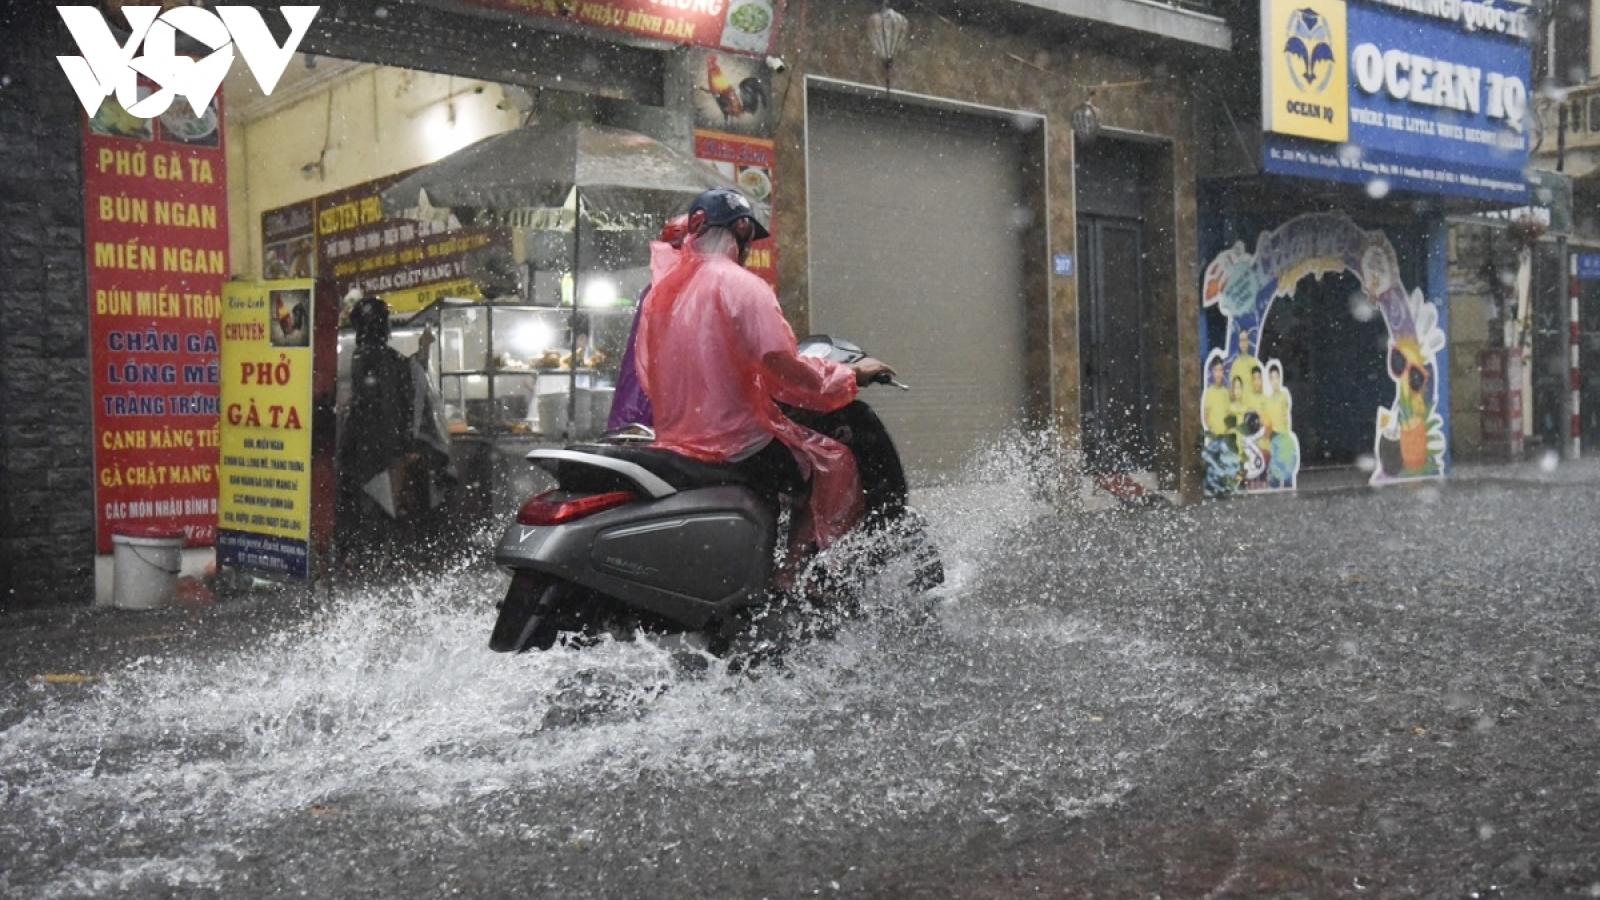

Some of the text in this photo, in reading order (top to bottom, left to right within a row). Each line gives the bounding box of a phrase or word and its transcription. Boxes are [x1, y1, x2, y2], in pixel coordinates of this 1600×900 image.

[1352, 42, 1527, 133] OCEAN IQ
[1287, 99, 1333, 124] OCEAN IQ
[1351, 107, 1384, 126] WHERE
[1386, 113, 1404, 130] THE
[1406, 117, 1435, 135] LITTLE
[100, 144, 213, 184] PHỞ GÀ TA
[99, 191, 217, 229] BÚN NGAN
[95, 237, 224, 274] MIẾN NGAN
[96, 285, 132, 316] BÚN
[136, 285, 180, 317] MIẾN
[108, 327, 219, 354] CHÂN GÀ
[224, 318, 264, 341] CHUYÊN
[240, 354, 291, 386] PHỞ
[104, 391, 165, 416] TRÀNG
[227, 398, 302, 430] GÀ TA
[150, 425, 193, 449] MĂNG
[101, 461, 123, 487] GÀ
[127, 462, 166, 489] CHẶT
[170, 464, 212, 483] MANG
[105, 499, 127, 519] CÁC
[129, 498, 152, 518] MÓN
[155, 496, 182, 519] NHẬU
[184, 496, 208, 515] BÌNH
